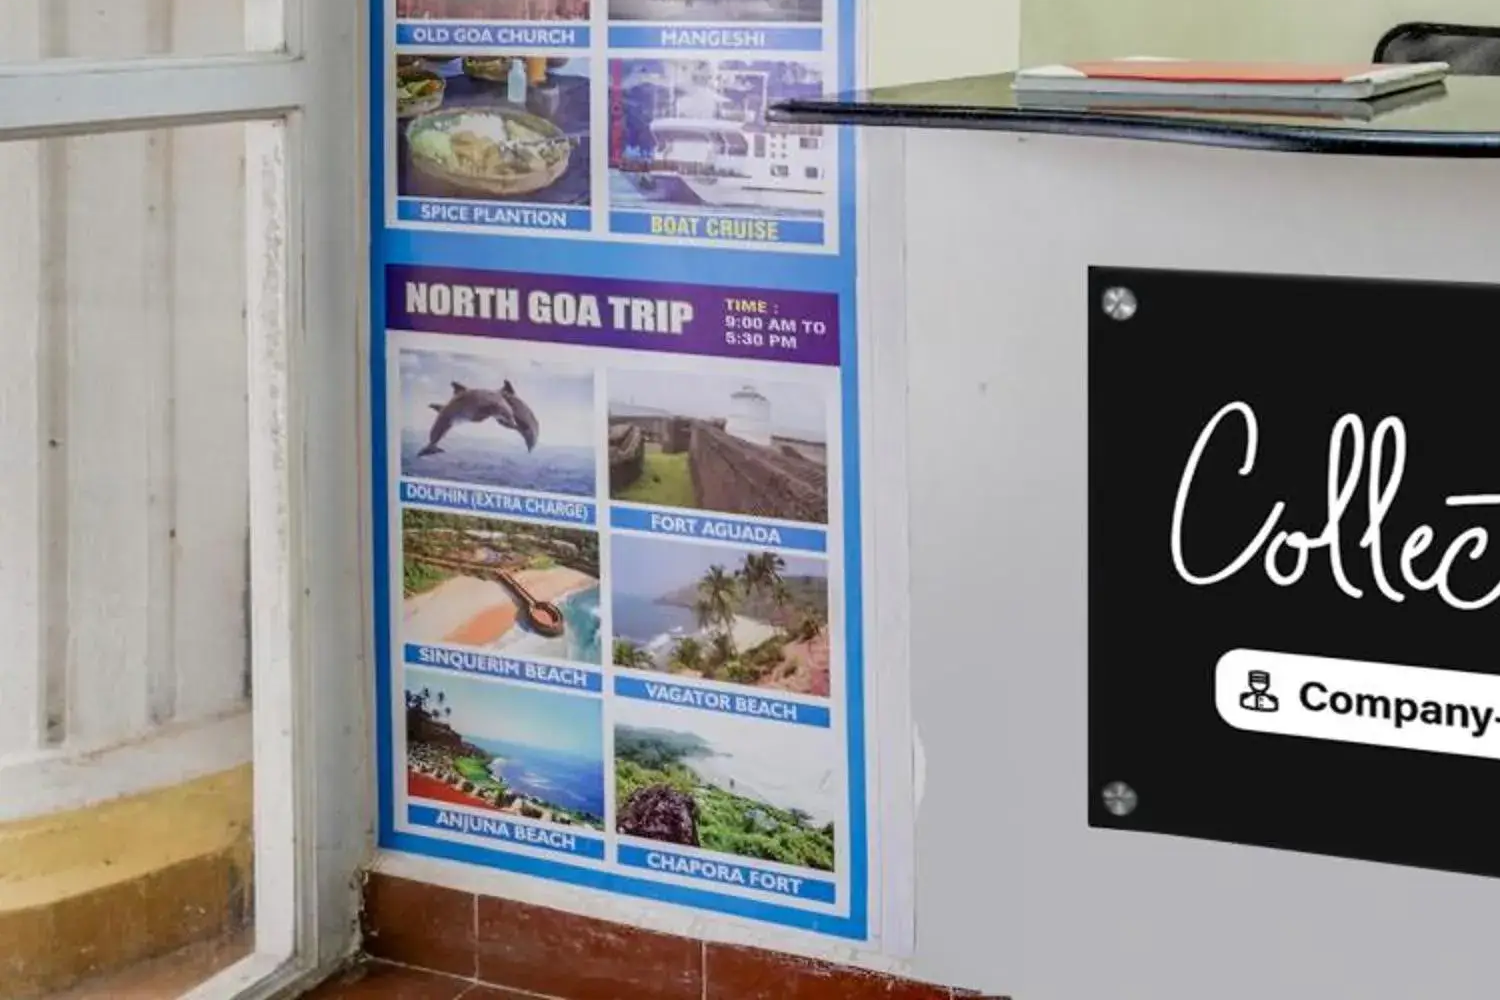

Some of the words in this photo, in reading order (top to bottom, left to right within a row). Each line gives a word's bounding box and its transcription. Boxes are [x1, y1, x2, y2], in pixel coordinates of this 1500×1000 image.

[413, 27, 449, 43] OLD
[454, 27, 494, 43] GOA
[498, 28, 575, 44] CHURCH
[421, 203, 469, 221] SPICE
[473, 206, 567, 227] PLANTION
[651, 215, 699, 235] BOAT
[706, 218, 780, 241] CRUISE
[404, 281, 519, 321] NORTH
[528, 289, 602, 328] GOA
[608, 295, 694, 335] TRIP
[725, 298, 768, 314] TIME
[725, 315, 764, 330] 9:00
[768, 317, 798, 333] AM
[802, 320, 827, 336] TO
[725, 331, 765, 348] 5:30
[768, 334, 798, 349] PM
[406, 483, 468, 505] DOLPHIN
[471, 490, 523, 512] (EXTRA
[525, 498, 588, 521] CHARGE)
[651, 512, 698, 532] FORT
[702, 518, 782, 545] AGUADA
[417, 647, 521, 677] SINQUERIM
[524, 664, 588, 687] BEACH
[643, 681, 732, 711] VAGATOR
[735, 695, 798, 721] BEACH
[436, 809, 510, 841] ANJUNA
[513, 826, 577, 851] BEACH
[646, 851, 743, 885] CHAPORA
[749, 870, 804, 895] FORT
